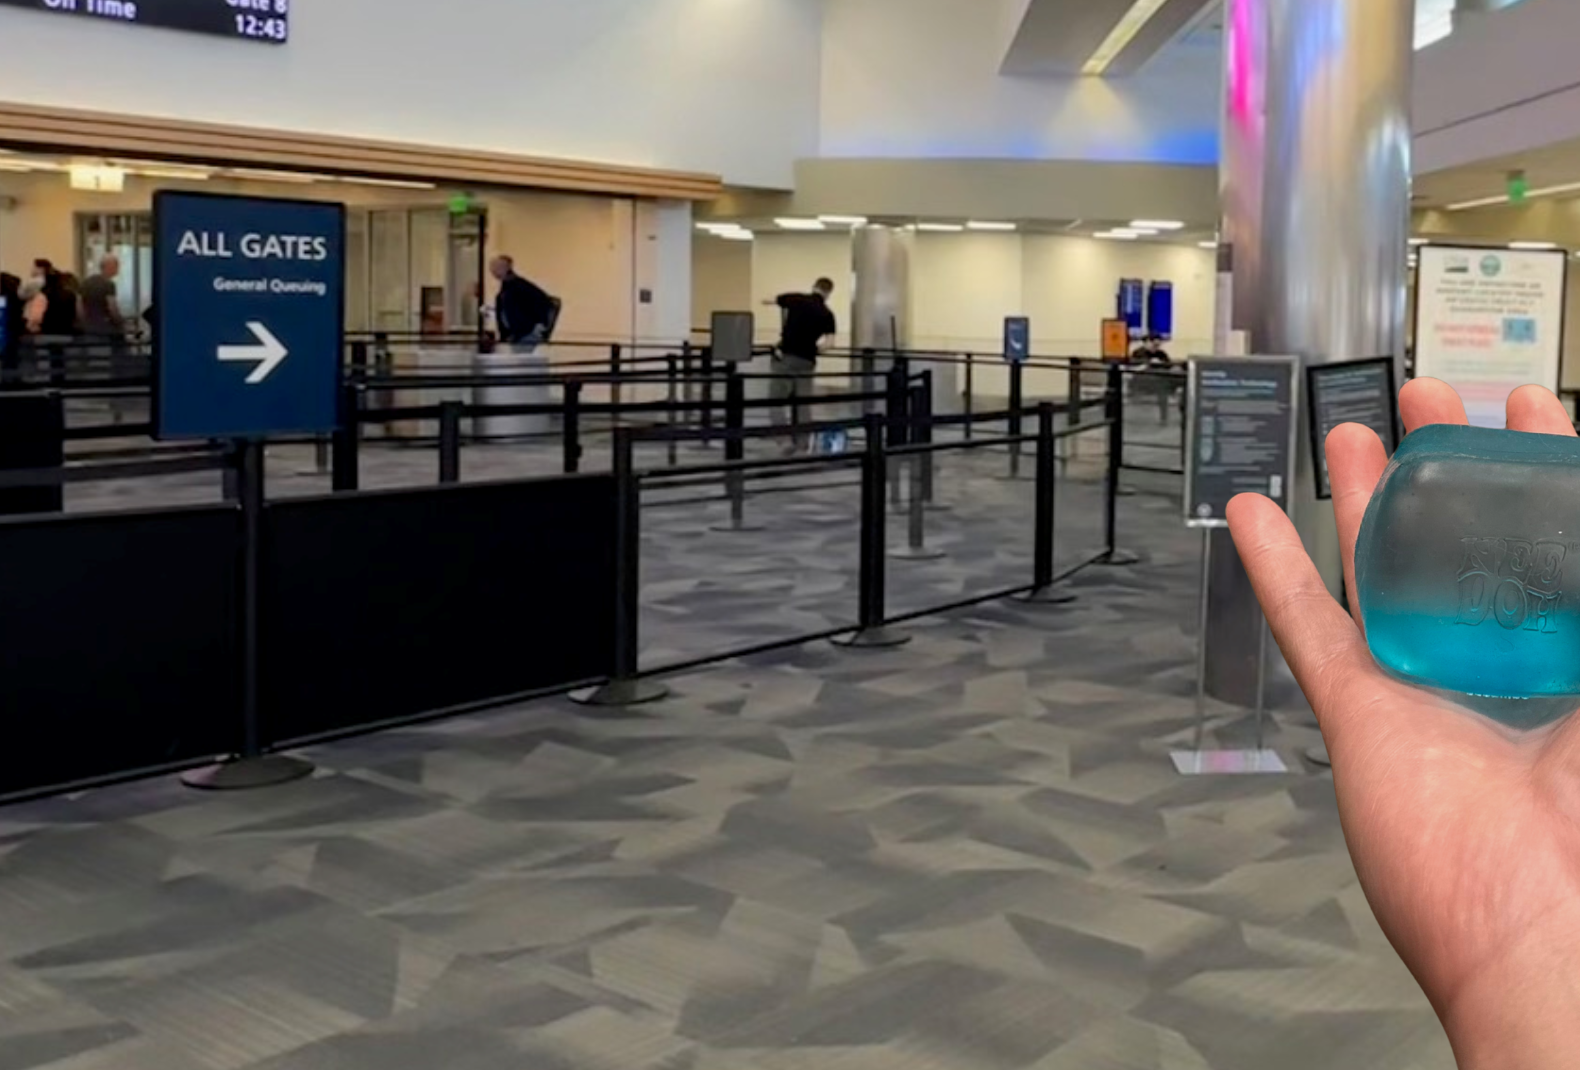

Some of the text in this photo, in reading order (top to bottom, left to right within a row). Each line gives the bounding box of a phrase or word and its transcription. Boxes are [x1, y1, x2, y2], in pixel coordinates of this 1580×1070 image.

[235, 14, 286, 39] 12:43
[177, 230, 328, 260] ALL GATES
[213, 277, 327, 296] General Queuing
[1453, 570, 1563, 634] DOH
